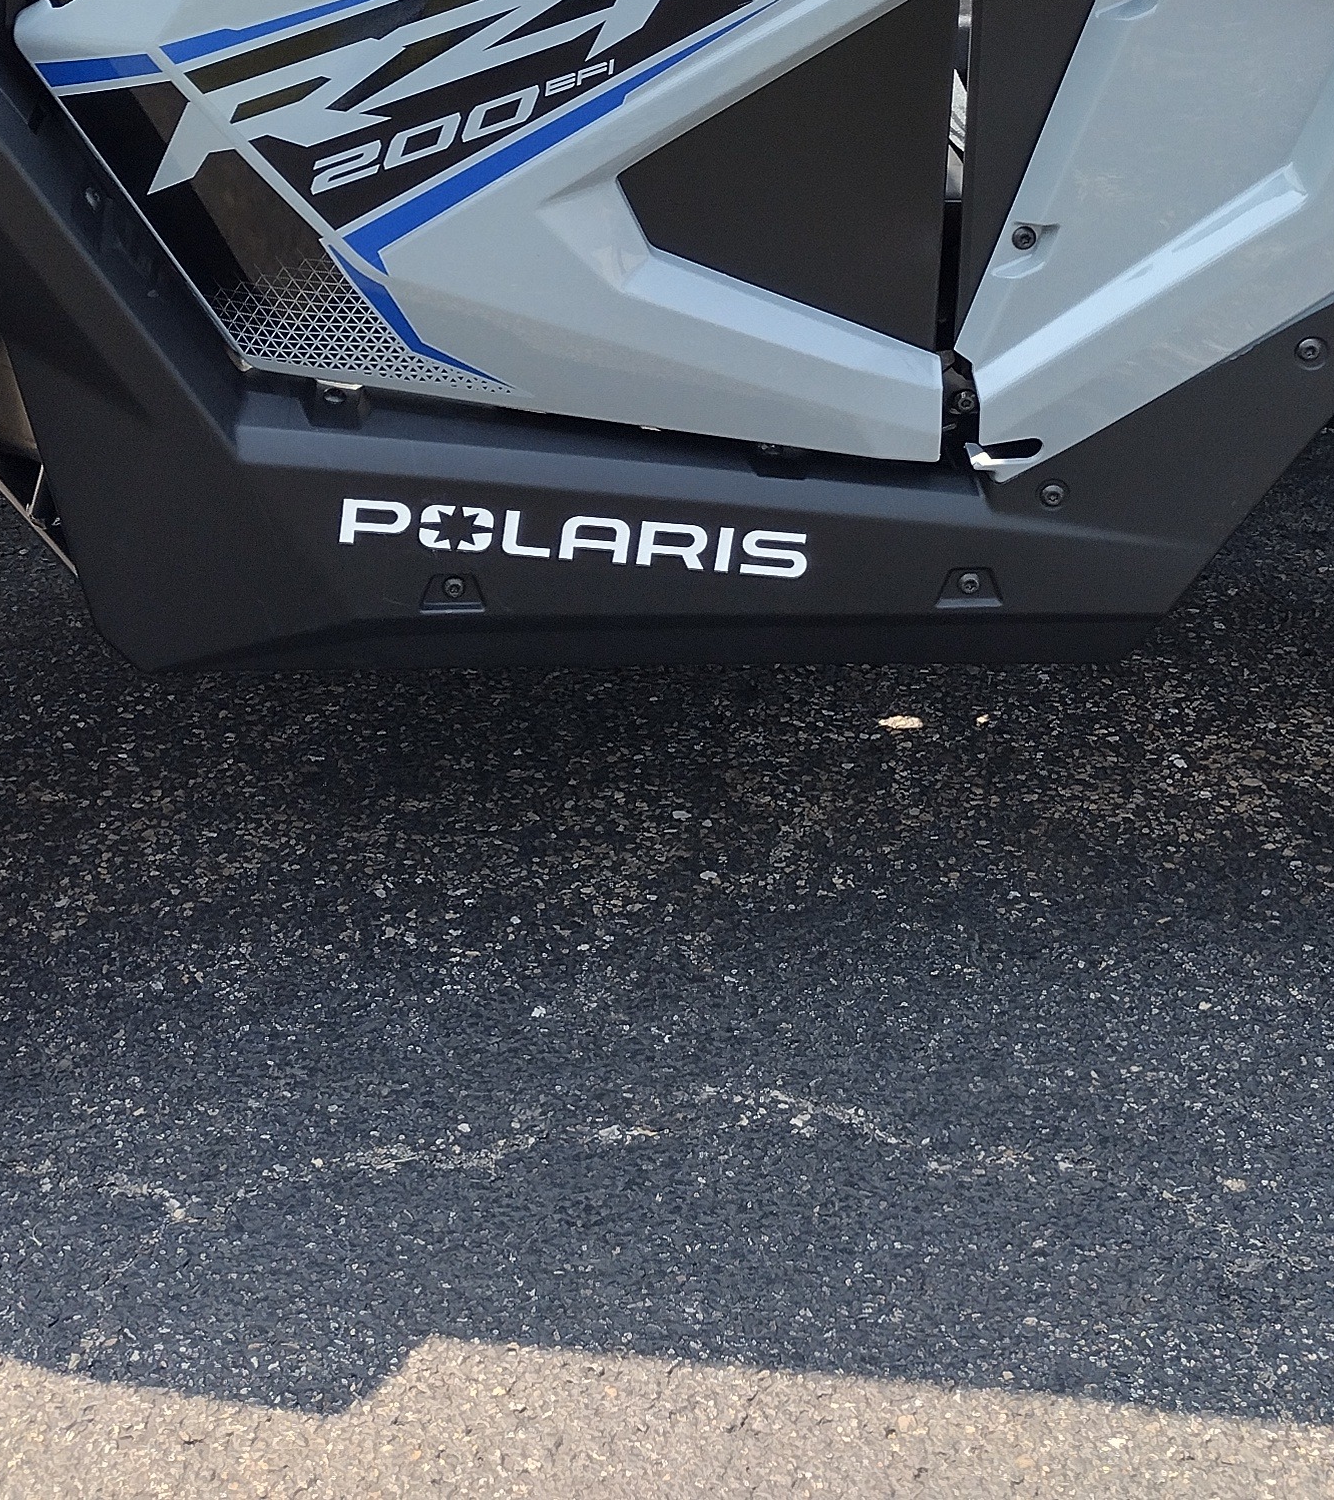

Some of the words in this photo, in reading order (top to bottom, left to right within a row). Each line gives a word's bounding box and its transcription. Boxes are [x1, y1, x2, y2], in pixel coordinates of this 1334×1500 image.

[310, 85, 542, 195] 200
[544, 58, 615, 97] EFI
[339, 497, 808, 579] POLARIS
